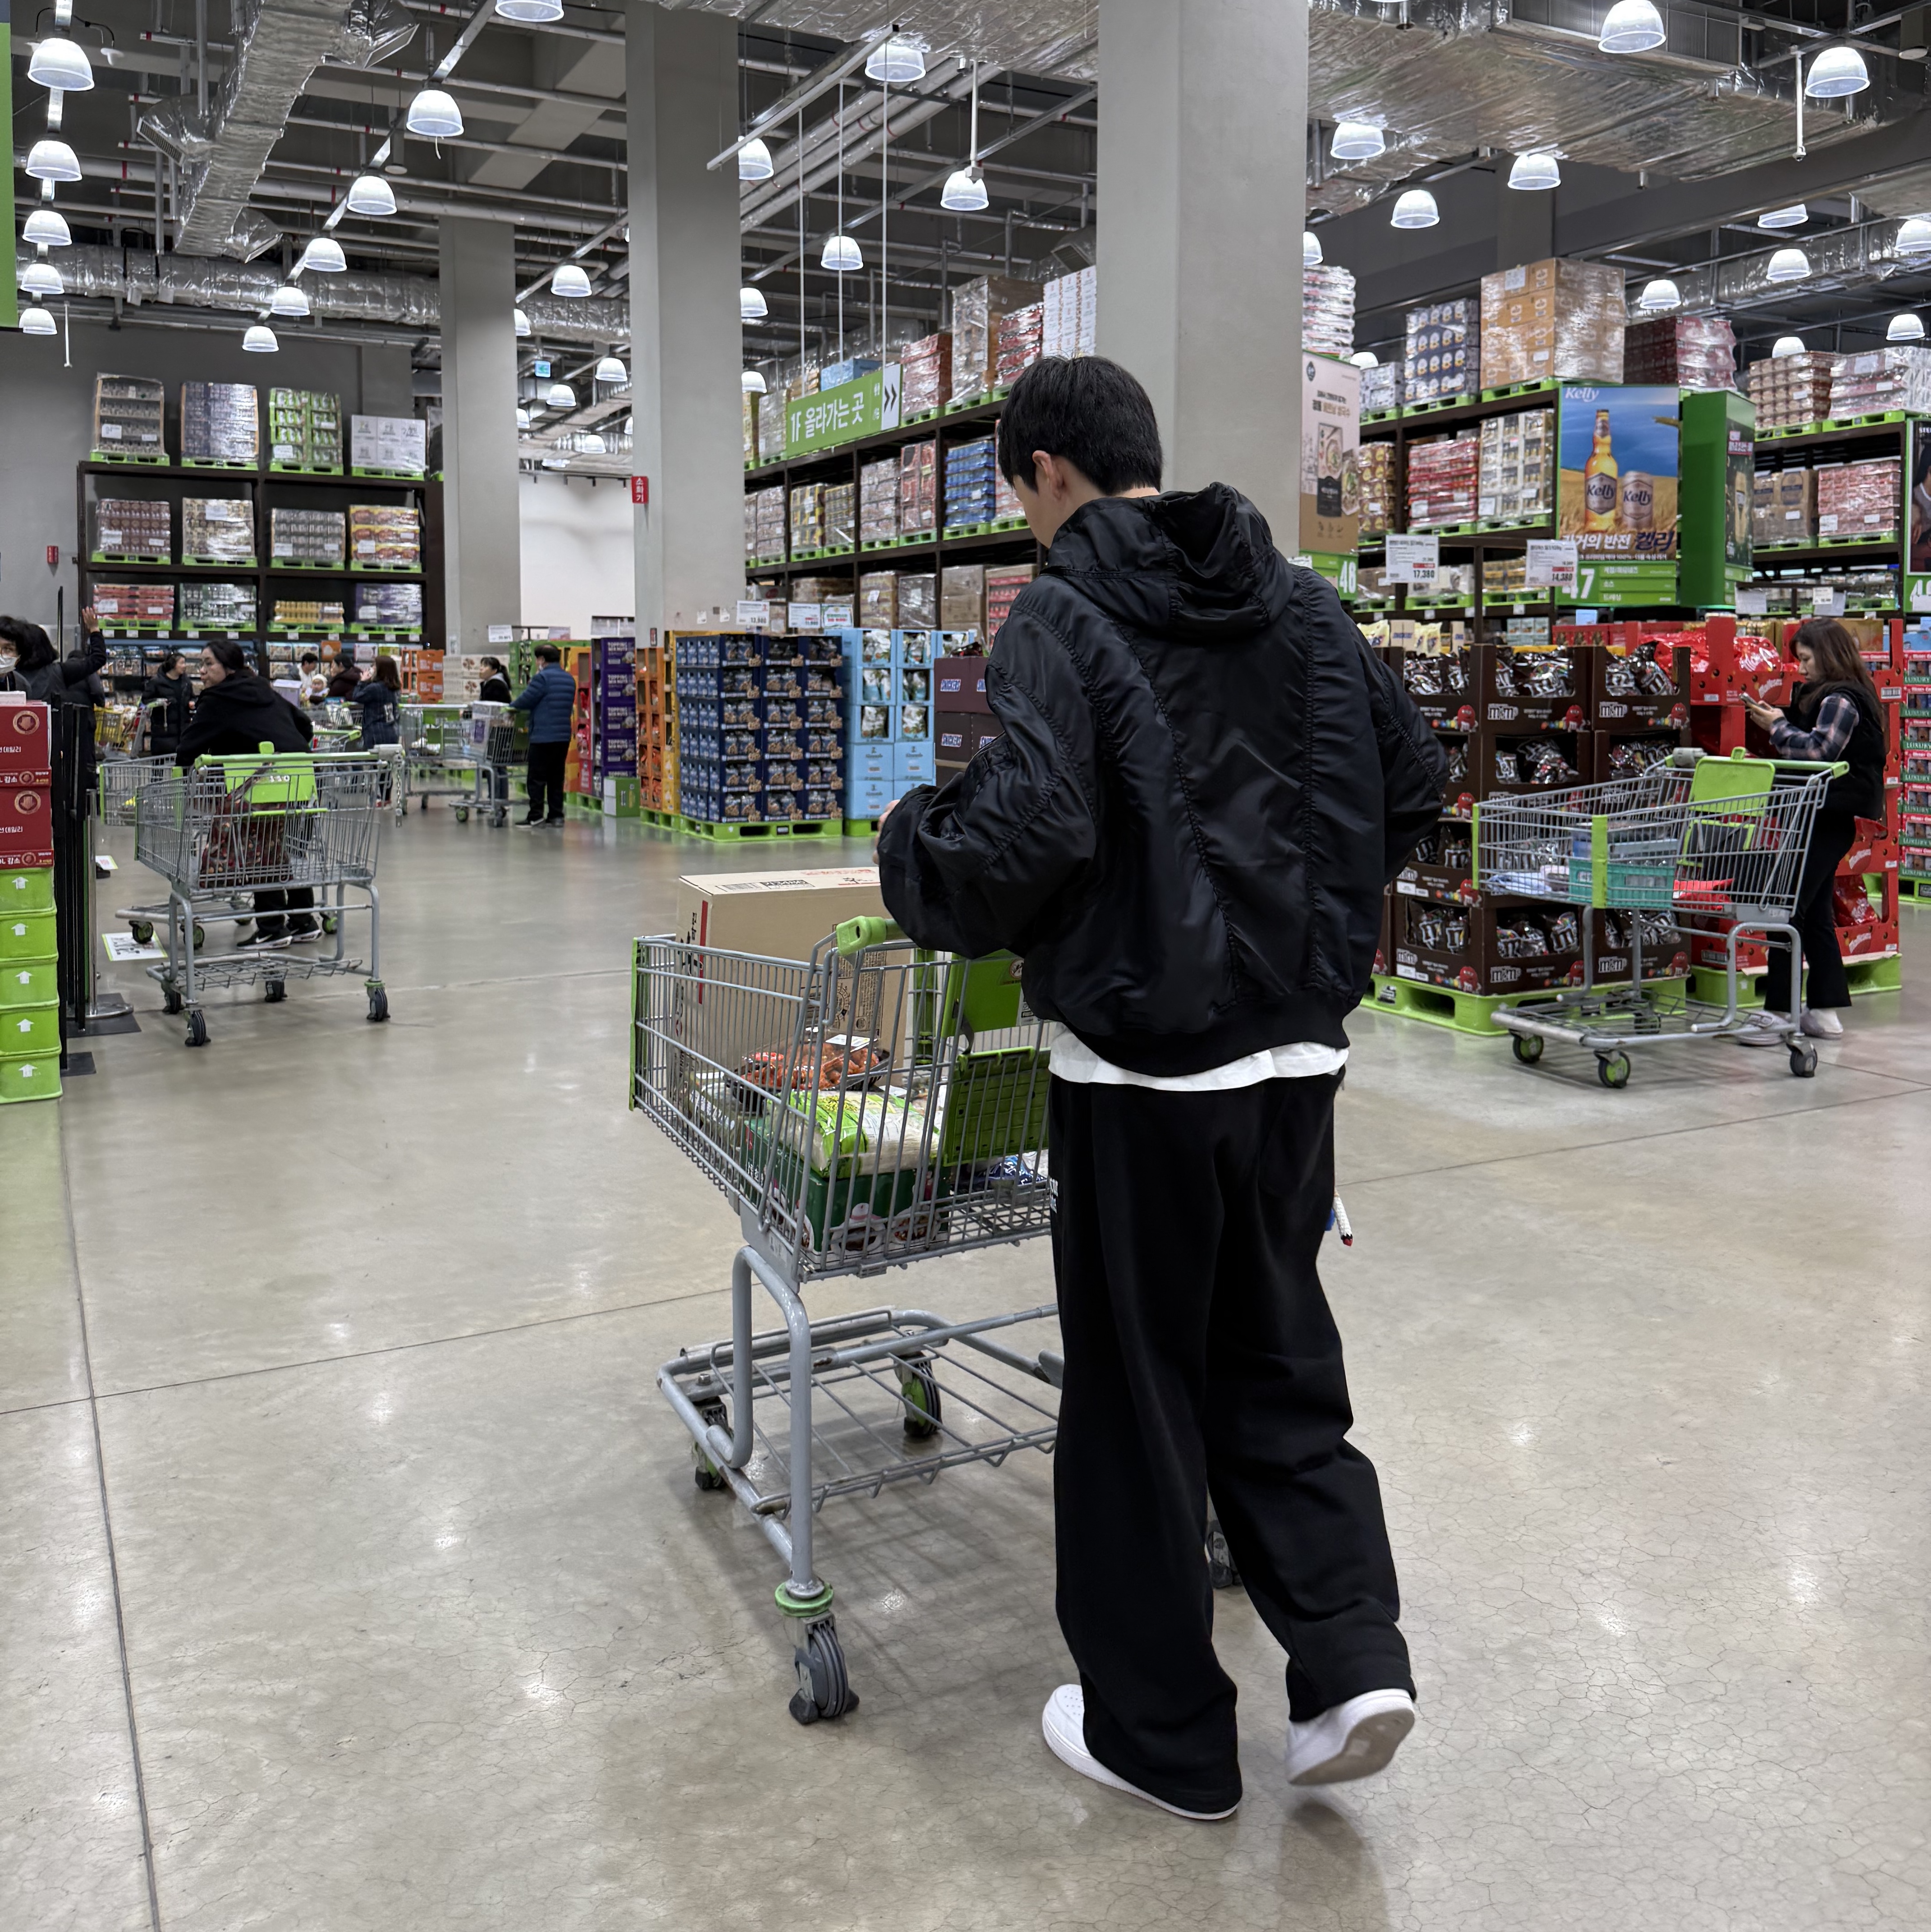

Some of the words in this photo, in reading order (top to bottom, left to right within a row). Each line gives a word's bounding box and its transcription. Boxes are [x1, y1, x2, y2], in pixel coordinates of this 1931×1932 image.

[1565, 387, 1599, 402] Kelly
[791, 411, 802, 442] 1F
[805, 398, 850, 439] 올라가는
[852, 392, 864, 425] 곳
[636, 477, 644, 502] 소화기
[1587, 484, 1616, 500] Kelly
[1624, 490, 1651, 506] Kelly
[1604, 533, 1631, 550] 반전
[1635, 531, 1675, 552] 켈리
[1339, 561, 1357, 594] 48
